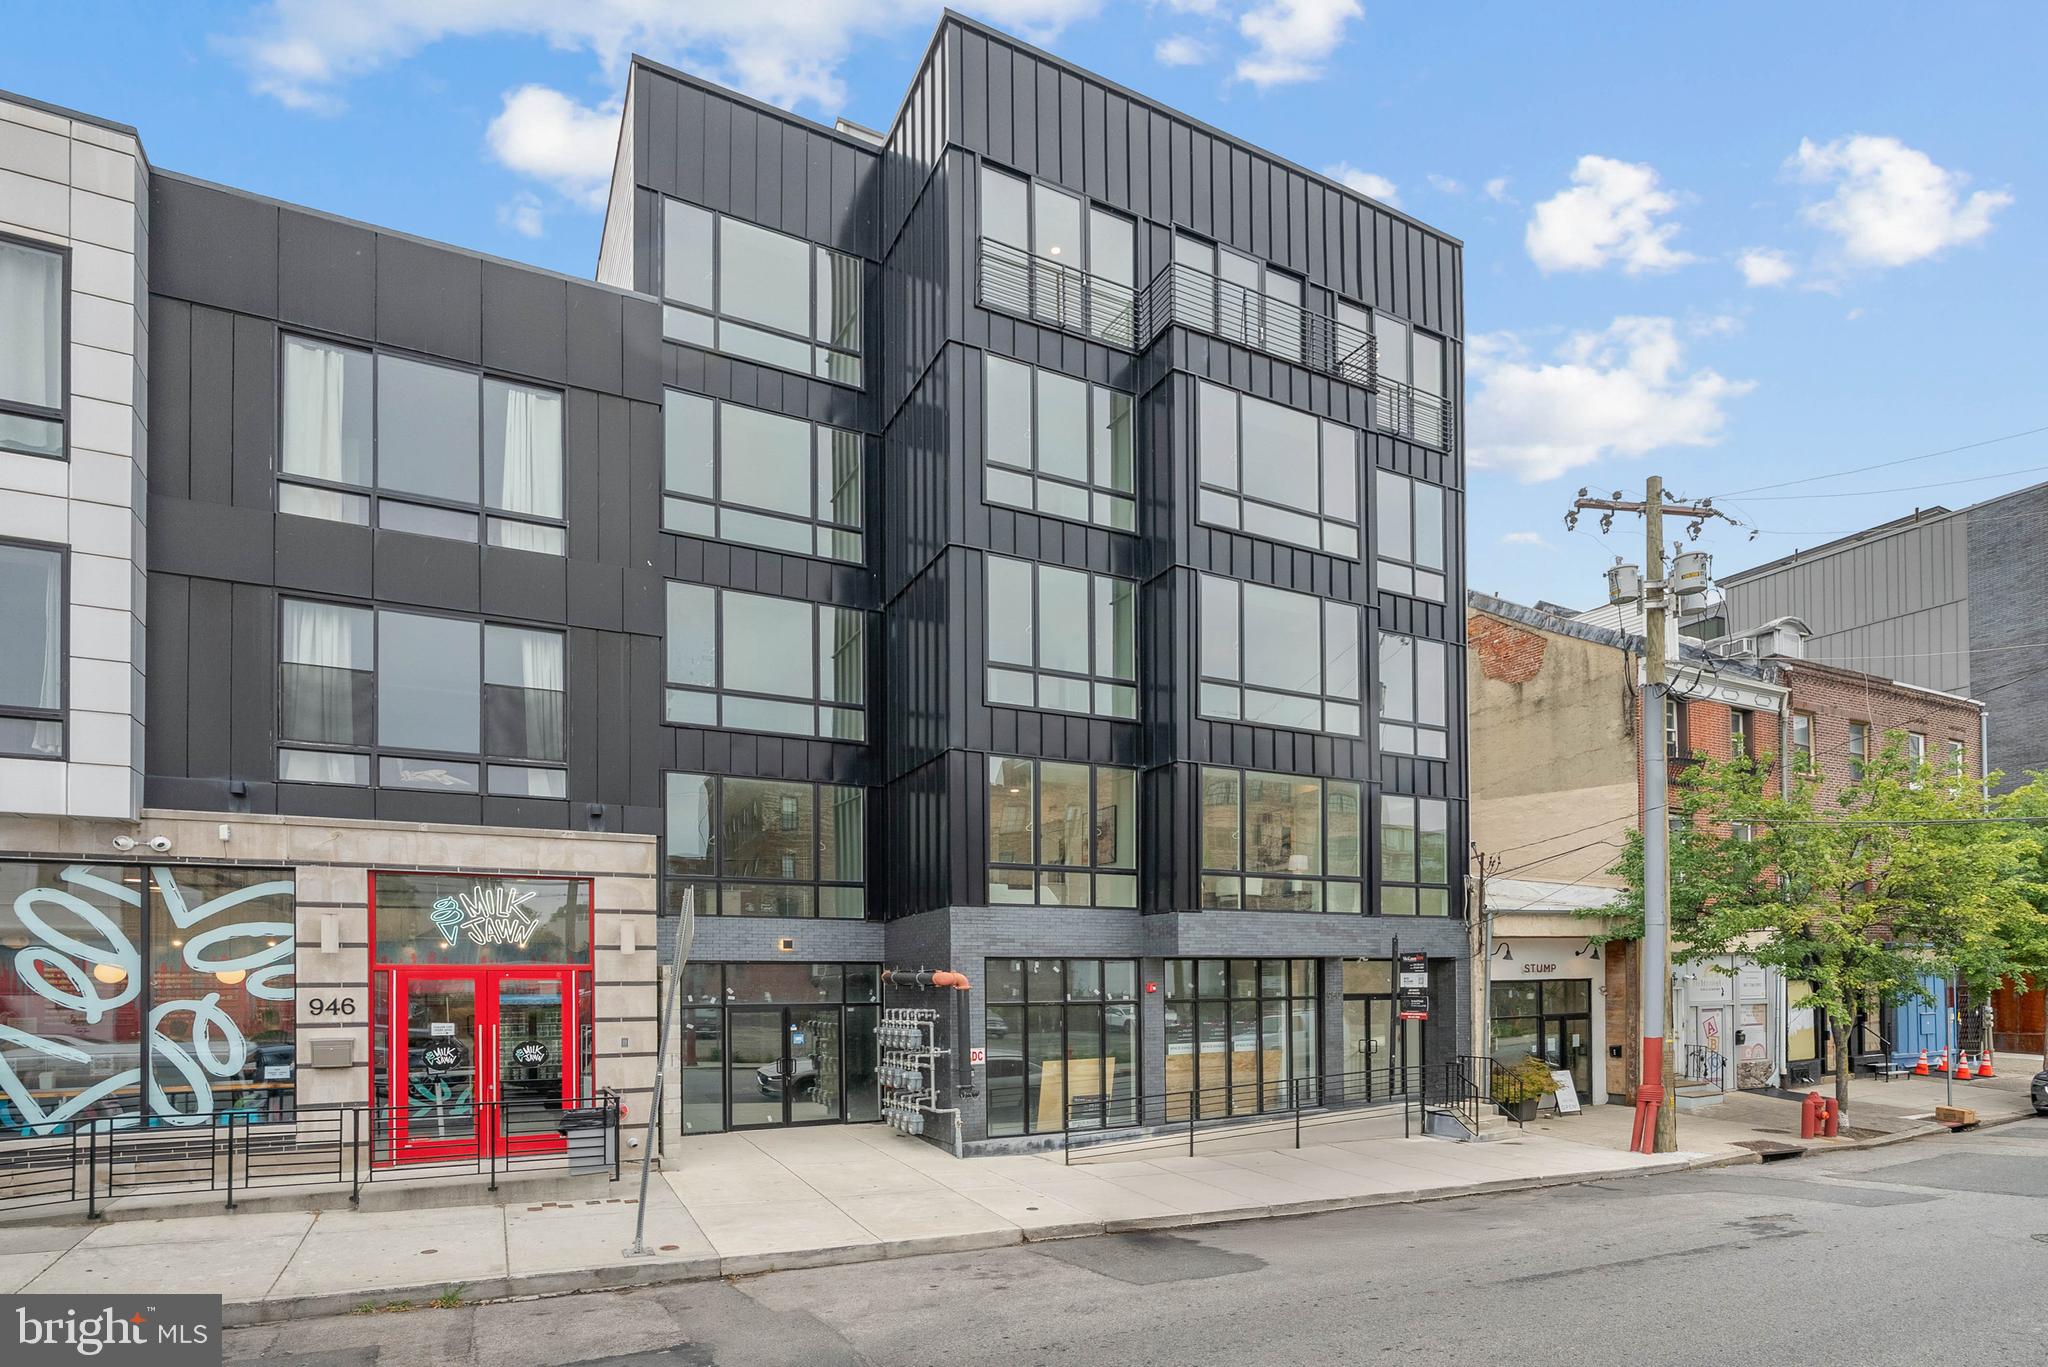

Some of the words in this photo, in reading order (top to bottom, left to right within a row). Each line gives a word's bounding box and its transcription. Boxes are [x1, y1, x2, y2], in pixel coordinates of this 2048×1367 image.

[459, 886, 537, 925] MILK
[460, 916, 539, 946] JAWN
[1524, 963, 1557, 973] STUMP
[309, 997, 356, 1016] 946
[1707, 1021, 1716, 1035] A
[433, 1047, 456, 1058] MILK
[523, 1045, 545, 1056] MILK
[971, 1051, 983, 1061] DC
[434, 1055, 457, 1065] JAWN
[524, 1053, 545, 1062] JAWN
